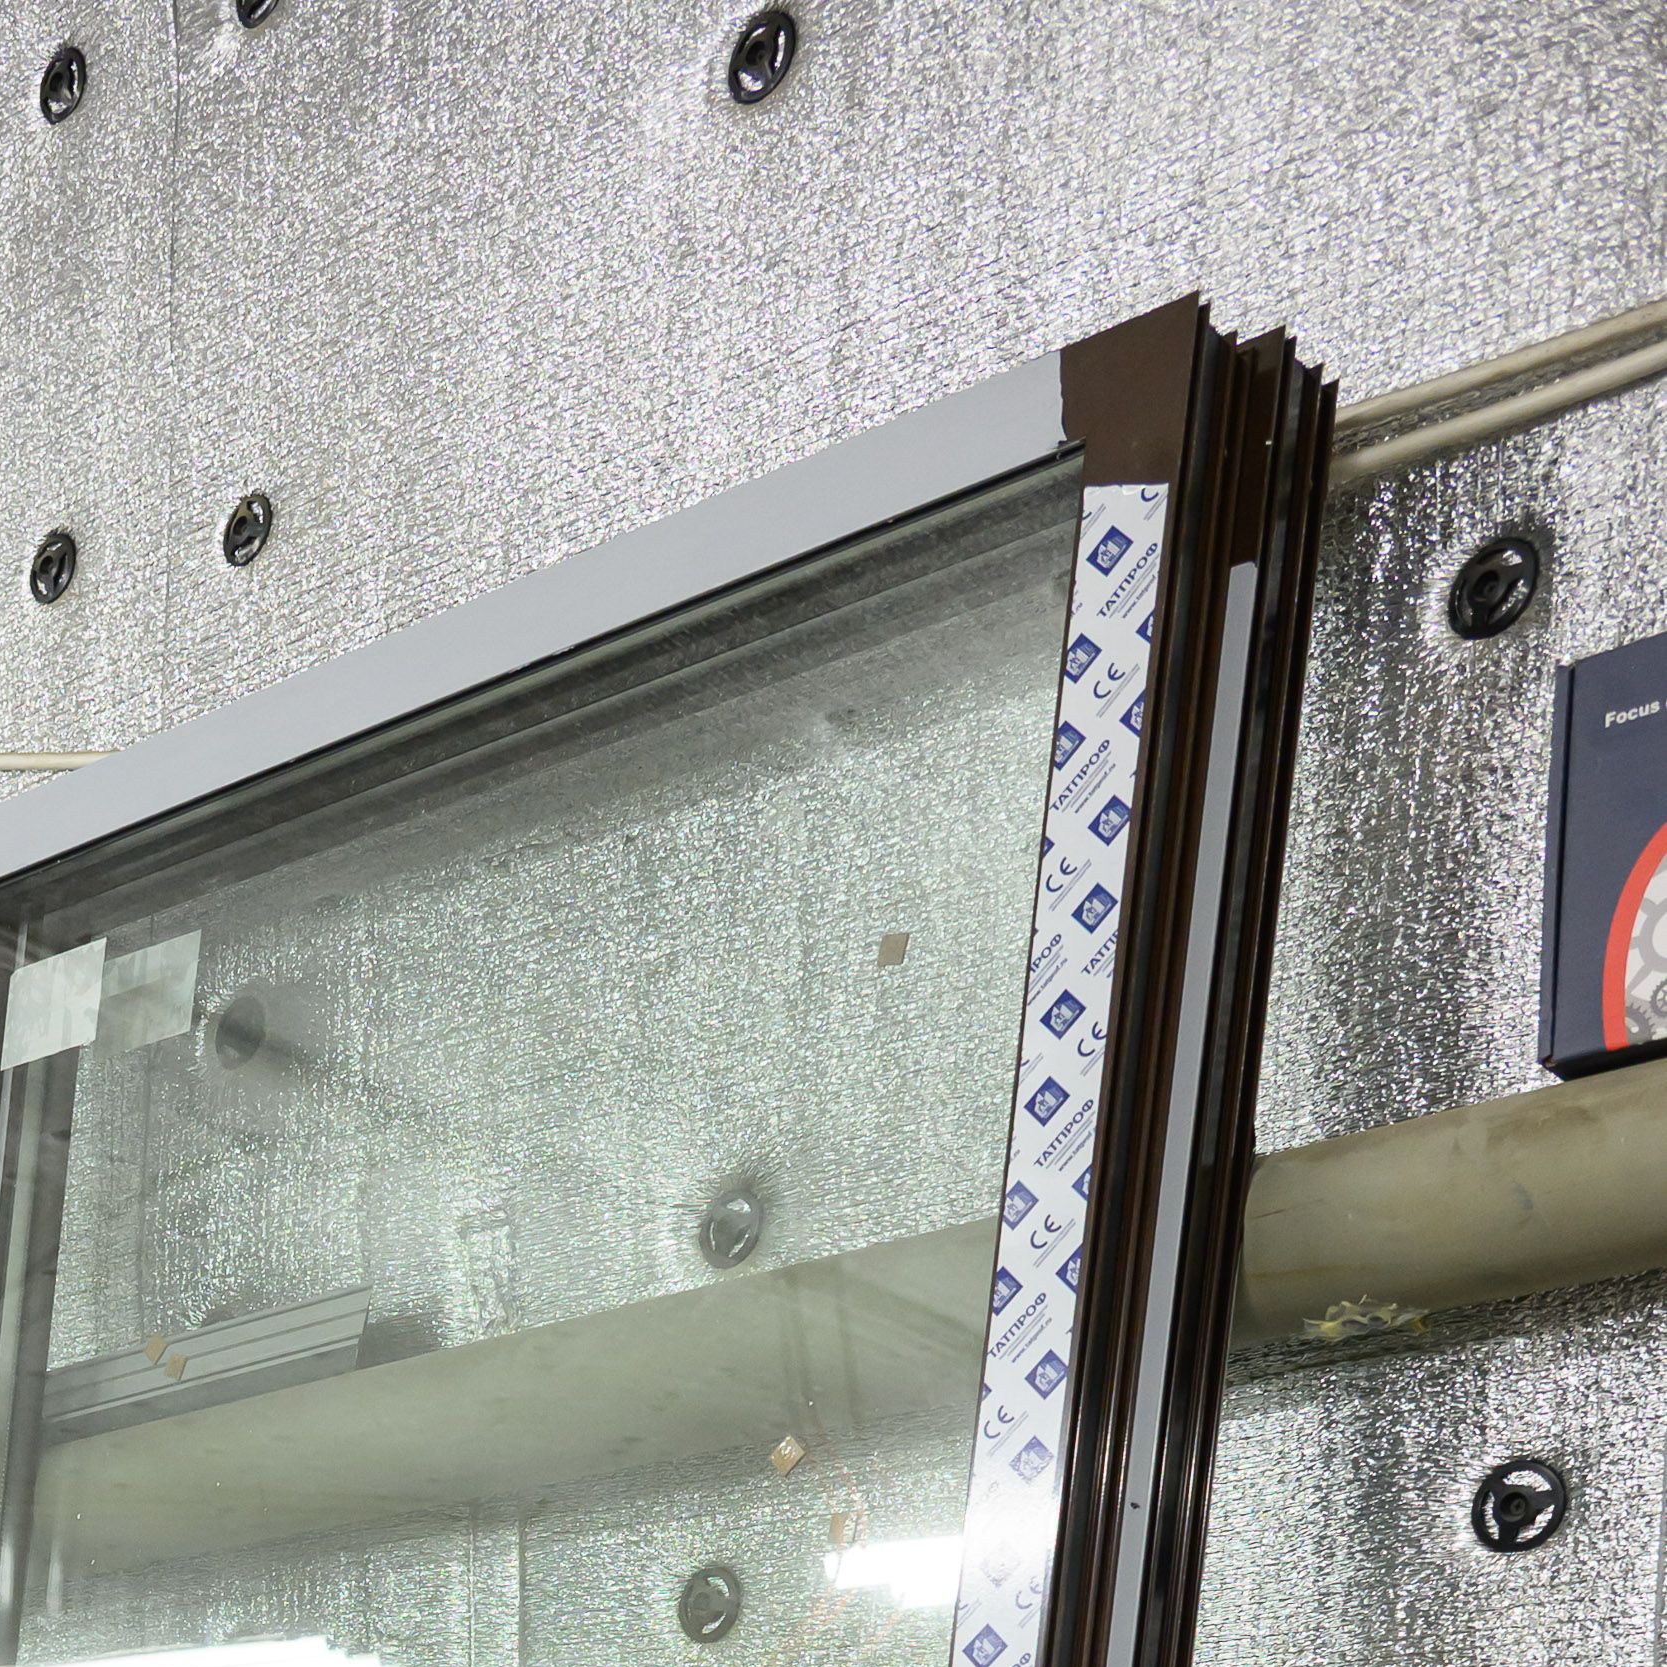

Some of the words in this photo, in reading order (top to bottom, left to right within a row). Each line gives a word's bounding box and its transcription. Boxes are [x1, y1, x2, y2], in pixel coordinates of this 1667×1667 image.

[1097, 543, 1158, 618] ТАТПРОФ
[1605, 701, 1660, 728] Focus
[1049, 739, 1110, 811] ТАТПРОФ
[1034, 1099, 1094, 1168] ТАТПРОФ
[988, 1292, 1047, 1358] ТАТПРОФ
